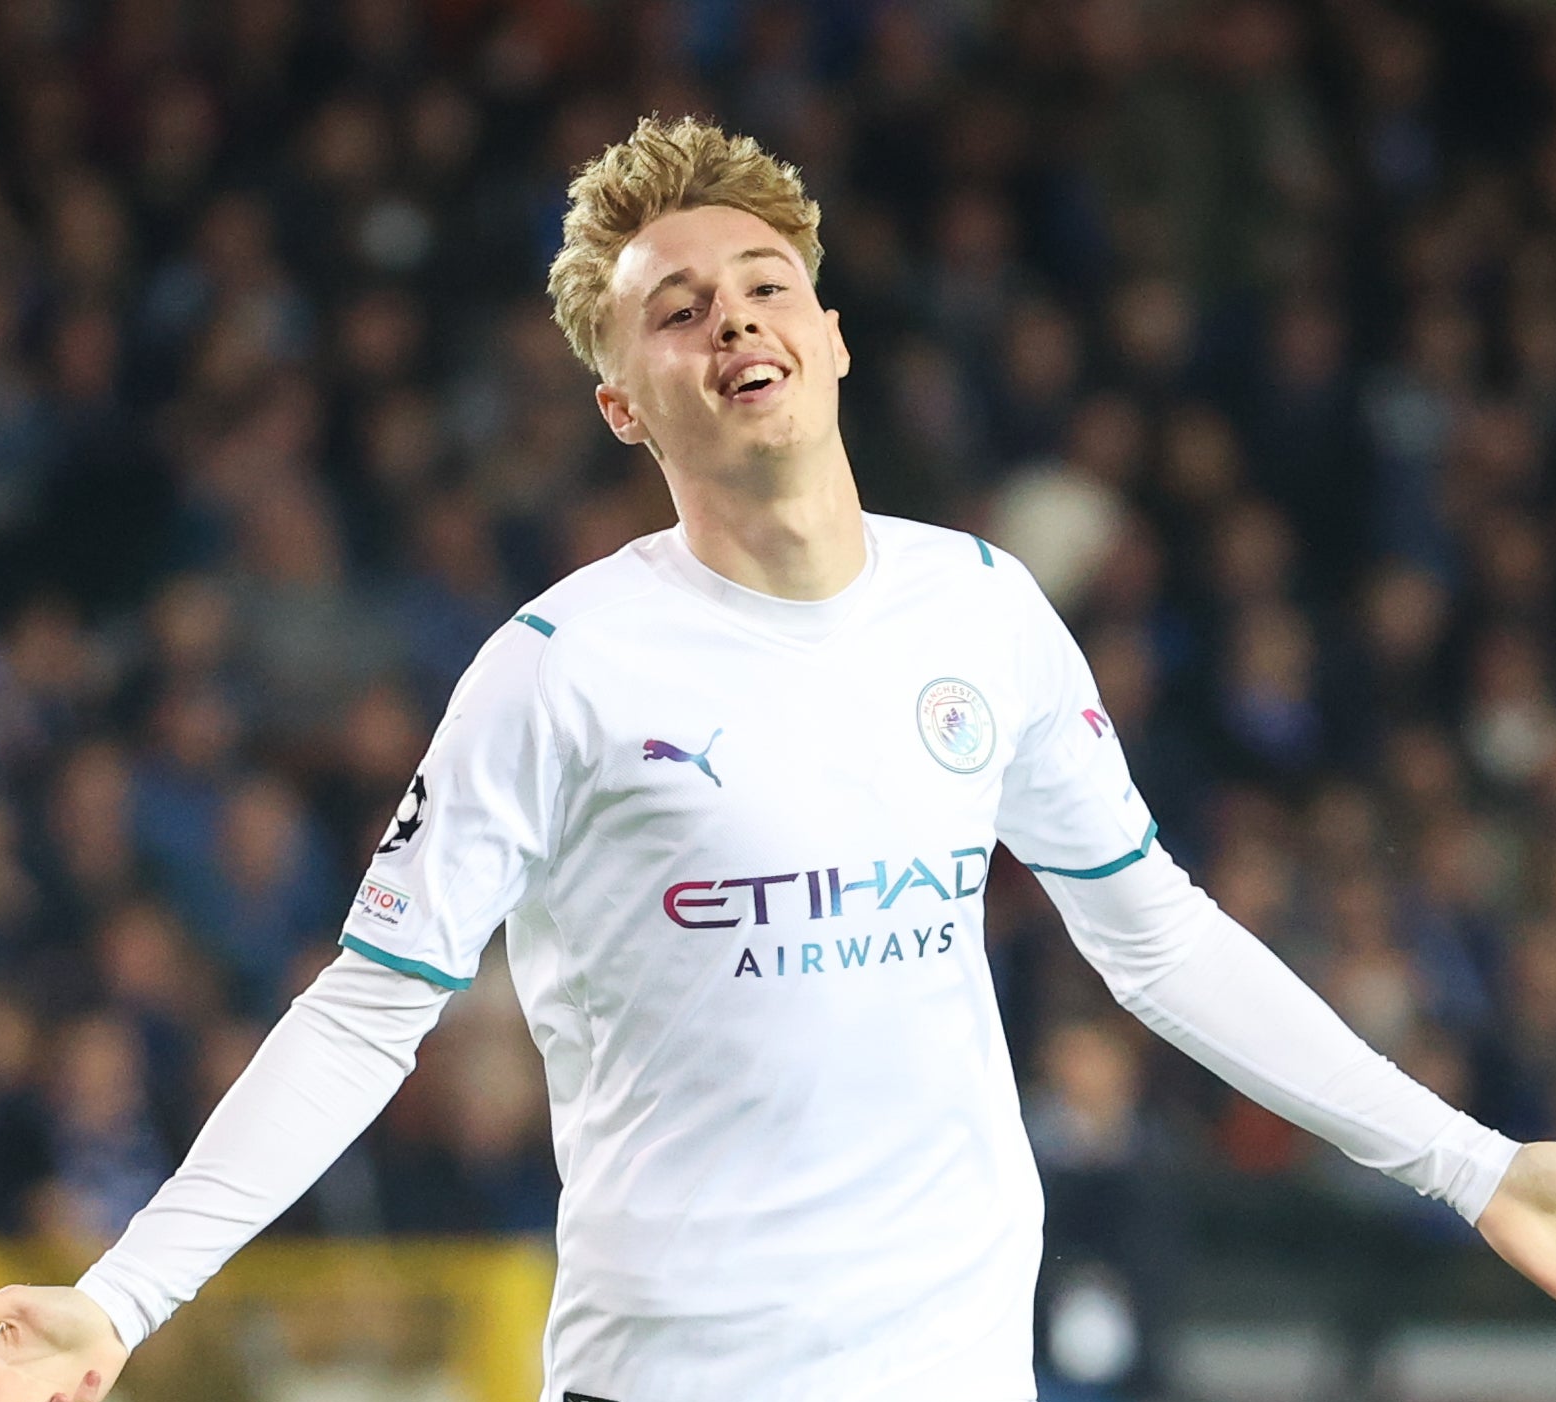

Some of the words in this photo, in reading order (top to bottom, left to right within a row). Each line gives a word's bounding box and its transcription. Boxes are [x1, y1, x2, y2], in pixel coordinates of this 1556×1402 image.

[923, 685, 984, 715] MANCHESTER
[955, 756, 977, 767] CITY
[663, 846, 988, 929] ETIHAD
[734, 922, 954, 978] AIRWAYS
